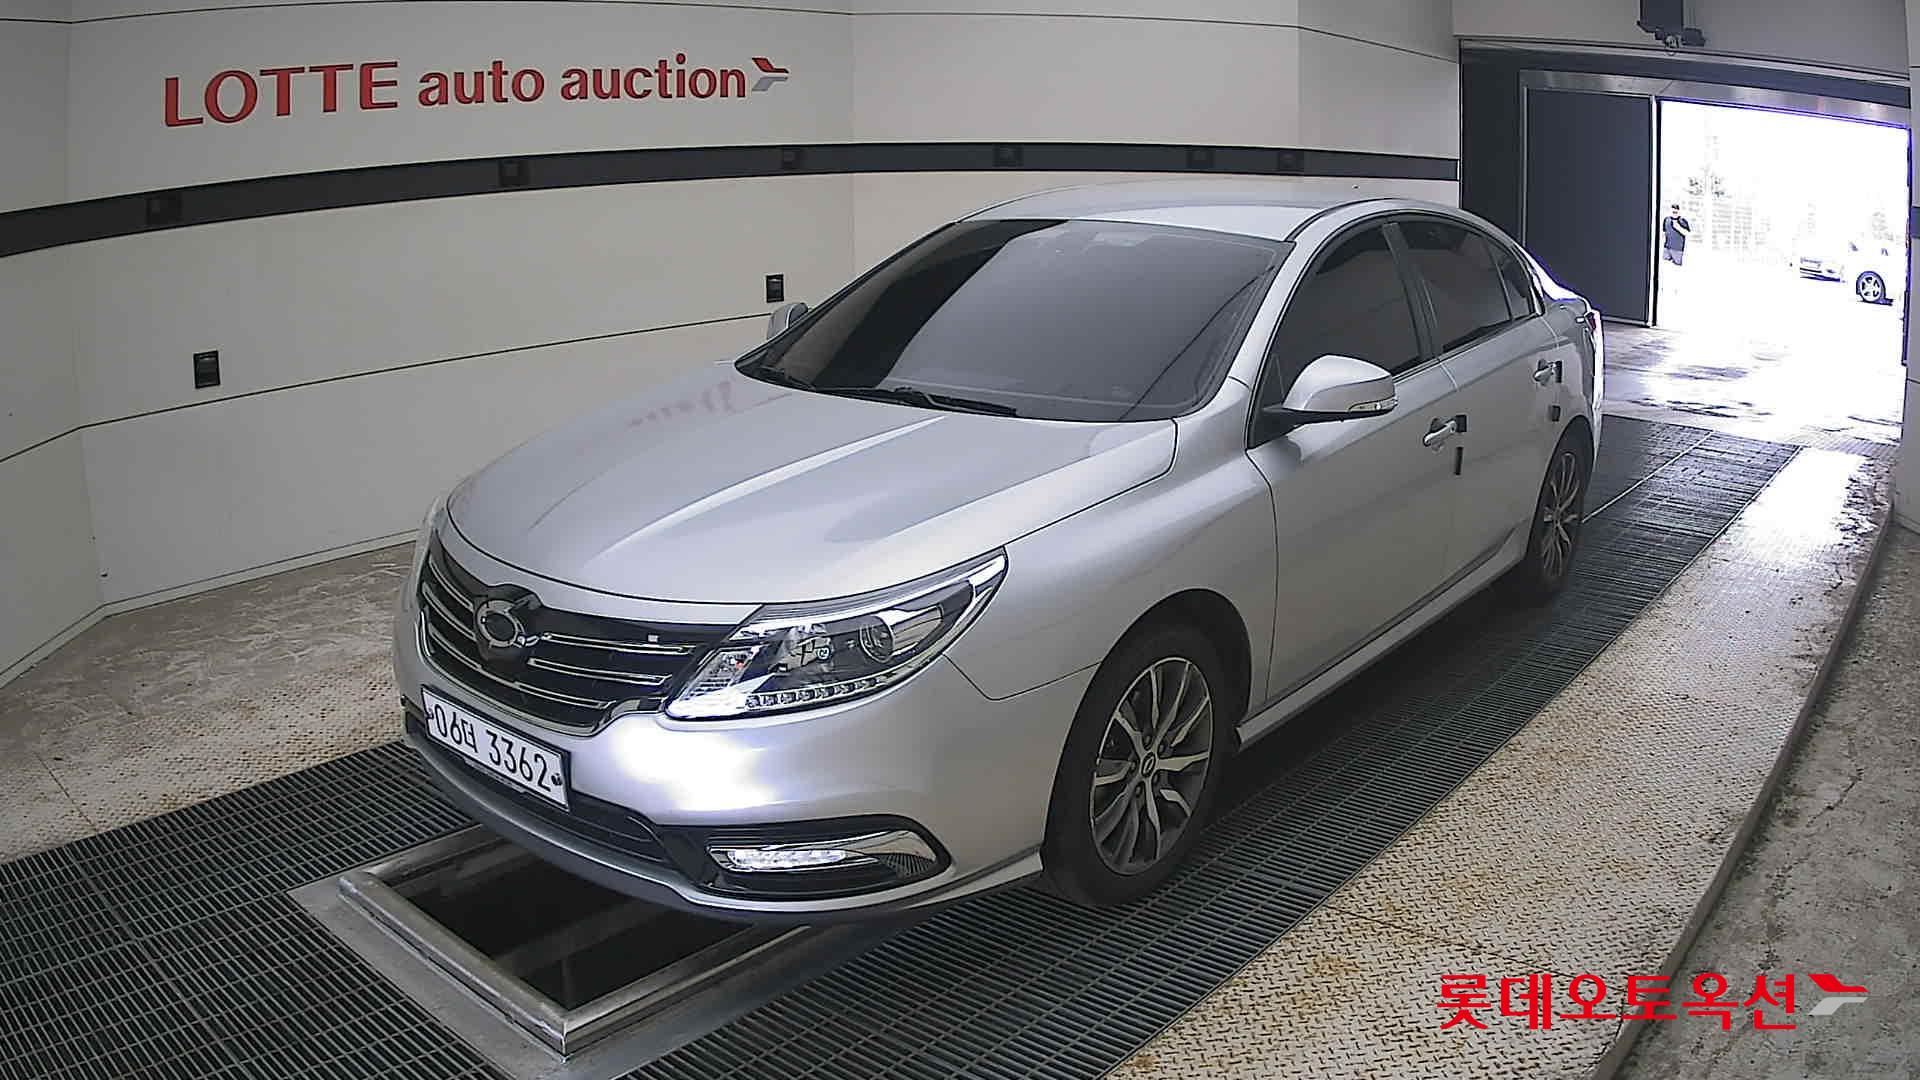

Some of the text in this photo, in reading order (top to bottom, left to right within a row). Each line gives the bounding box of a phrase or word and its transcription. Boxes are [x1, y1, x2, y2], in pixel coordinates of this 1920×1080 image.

[164, 53, 747, 127] LOTTE auto auction
[486, 729, 552, 792] 3362
